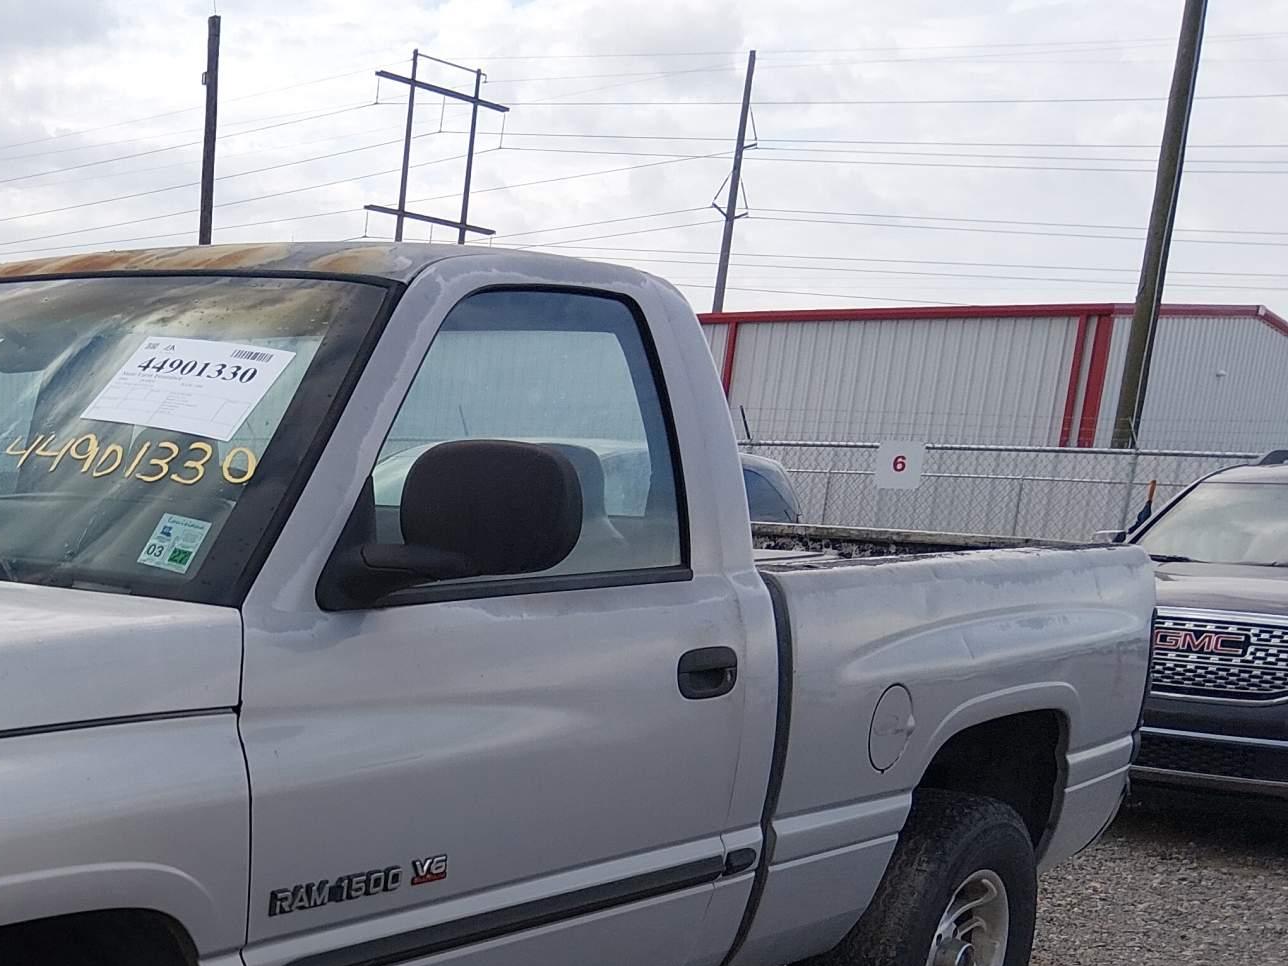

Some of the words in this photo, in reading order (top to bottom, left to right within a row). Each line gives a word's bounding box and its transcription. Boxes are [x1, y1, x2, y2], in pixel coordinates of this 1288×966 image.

[137, 356, 258, 384] 44901330
[5, 433, 257, 485] 44901330
[893, 455, 907, 472] 6
[146, 543, 165, 558] 03
[169, 549, 191, 564] 27
[1153, 628, 1245, 655] GMC
[268, 880, 329, 917] RAM
[334, 865, 403, 902] 1500
[411, 854, 447, 878] V6
